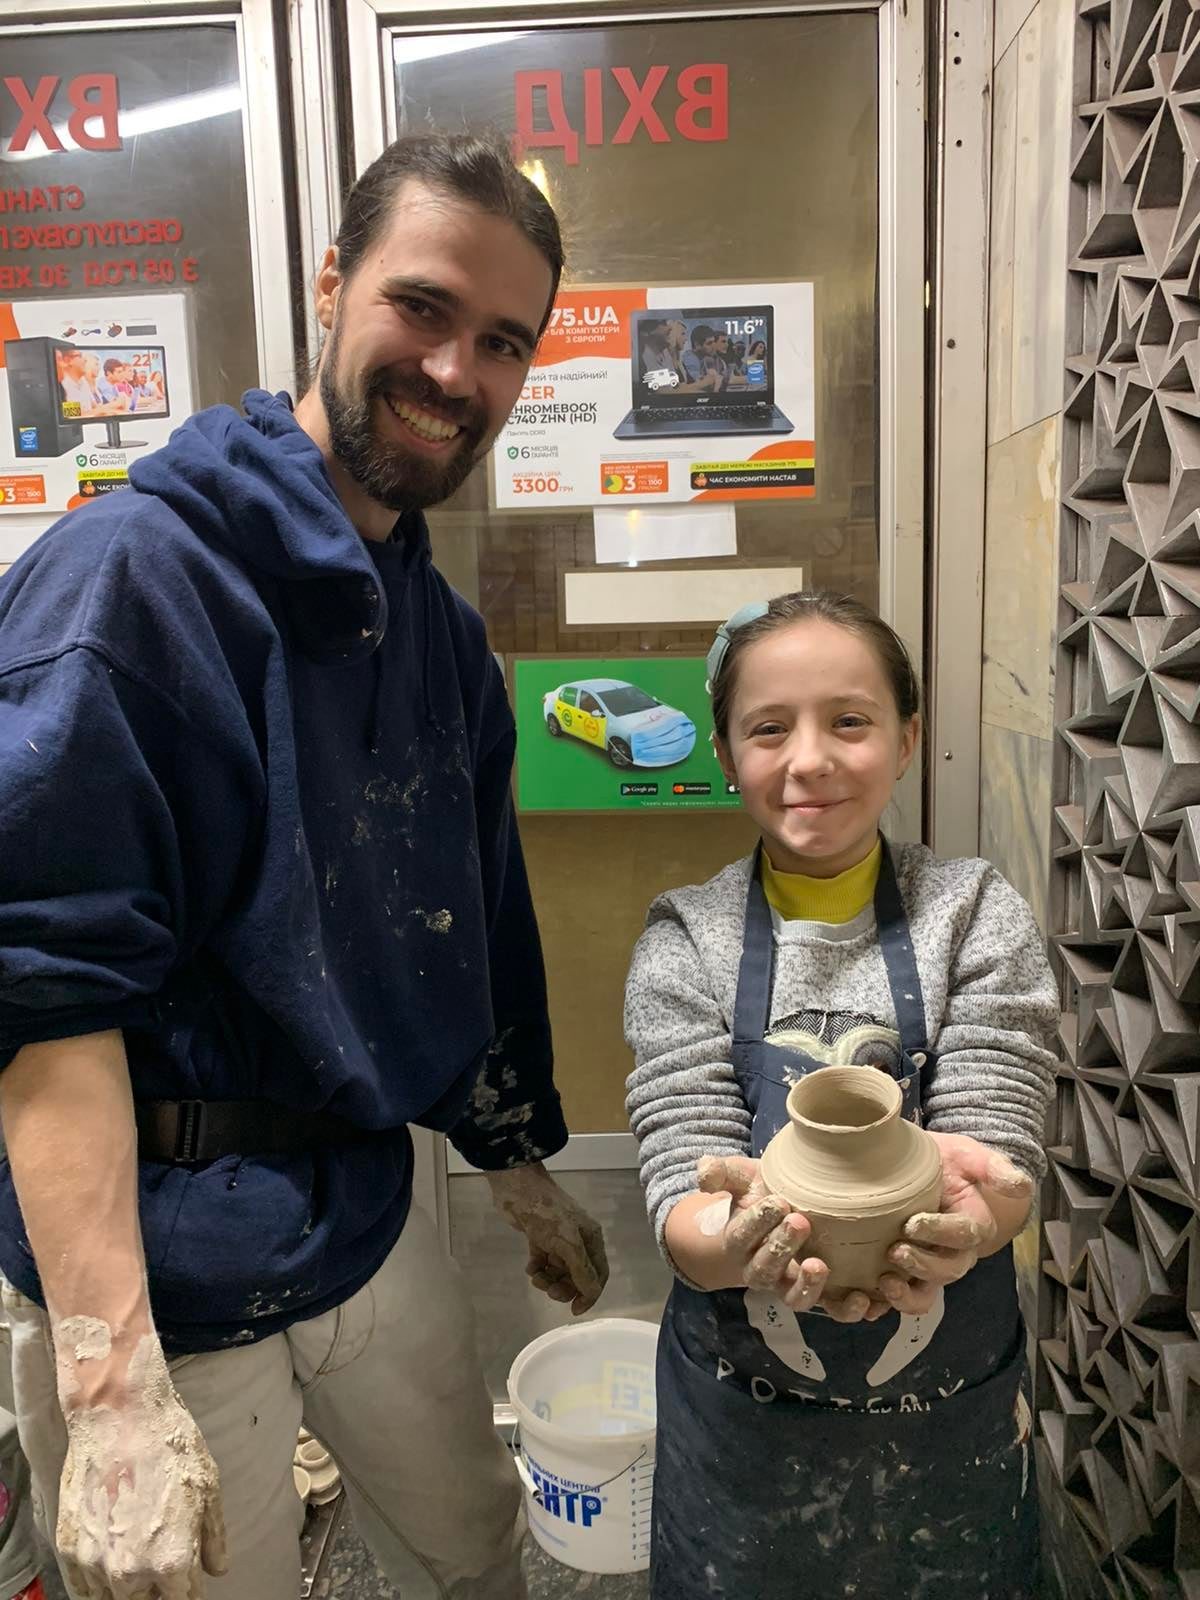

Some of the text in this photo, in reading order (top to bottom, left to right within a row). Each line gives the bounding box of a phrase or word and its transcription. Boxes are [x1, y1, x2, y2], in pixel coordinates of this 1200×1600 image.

[572, 334, 606, 344] ЄВРОПИ
[548, 373, 559, 382] та
[560, 370, 608, 382] надійний!
[540, 412, 567, 425] ZHN
[569, 411, 598, 425] (HD)
[521, 446, 531, 459] 6
[89, 453, 99, 467] 6
[623, 474, 637, 492] 3
[725, 475, 769, 483] ЕКОНОМИТИ
[769, 473, 797, 482] НАСТАВ
[97, 483, 111, 492] ЧАС
[512, 477, 559, 494] 3300
[4, 487, 16, 503] 3
